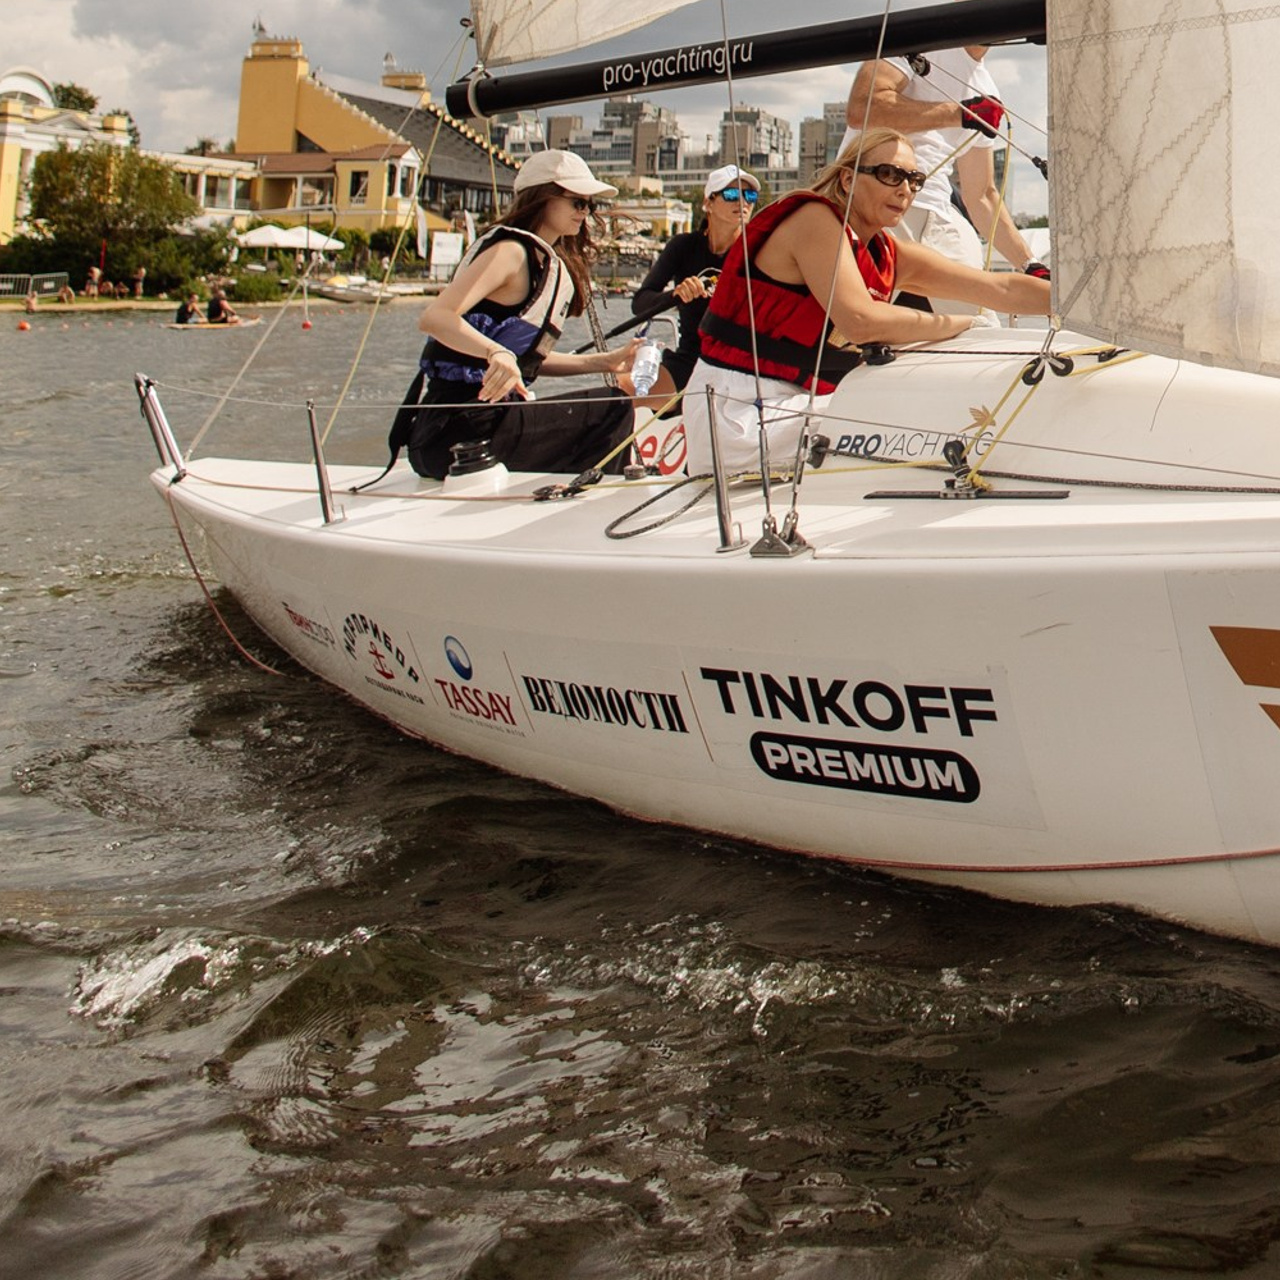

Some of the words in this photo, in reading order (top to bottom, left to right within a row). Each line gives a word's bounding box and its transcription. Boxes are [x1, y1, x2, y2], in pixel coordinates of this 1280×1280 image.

[602, 41, 753, 91] pro-yachtingru
[833, 431, 994, 457] PROYACHTG
[434, 678, 517, 726] TASSAY
[521, 675, 690, 734] ВЕДОМОСТИ
[700, 667, 998, 737] TINKOFF
[760, 740, 966, 793] PREMIUM
